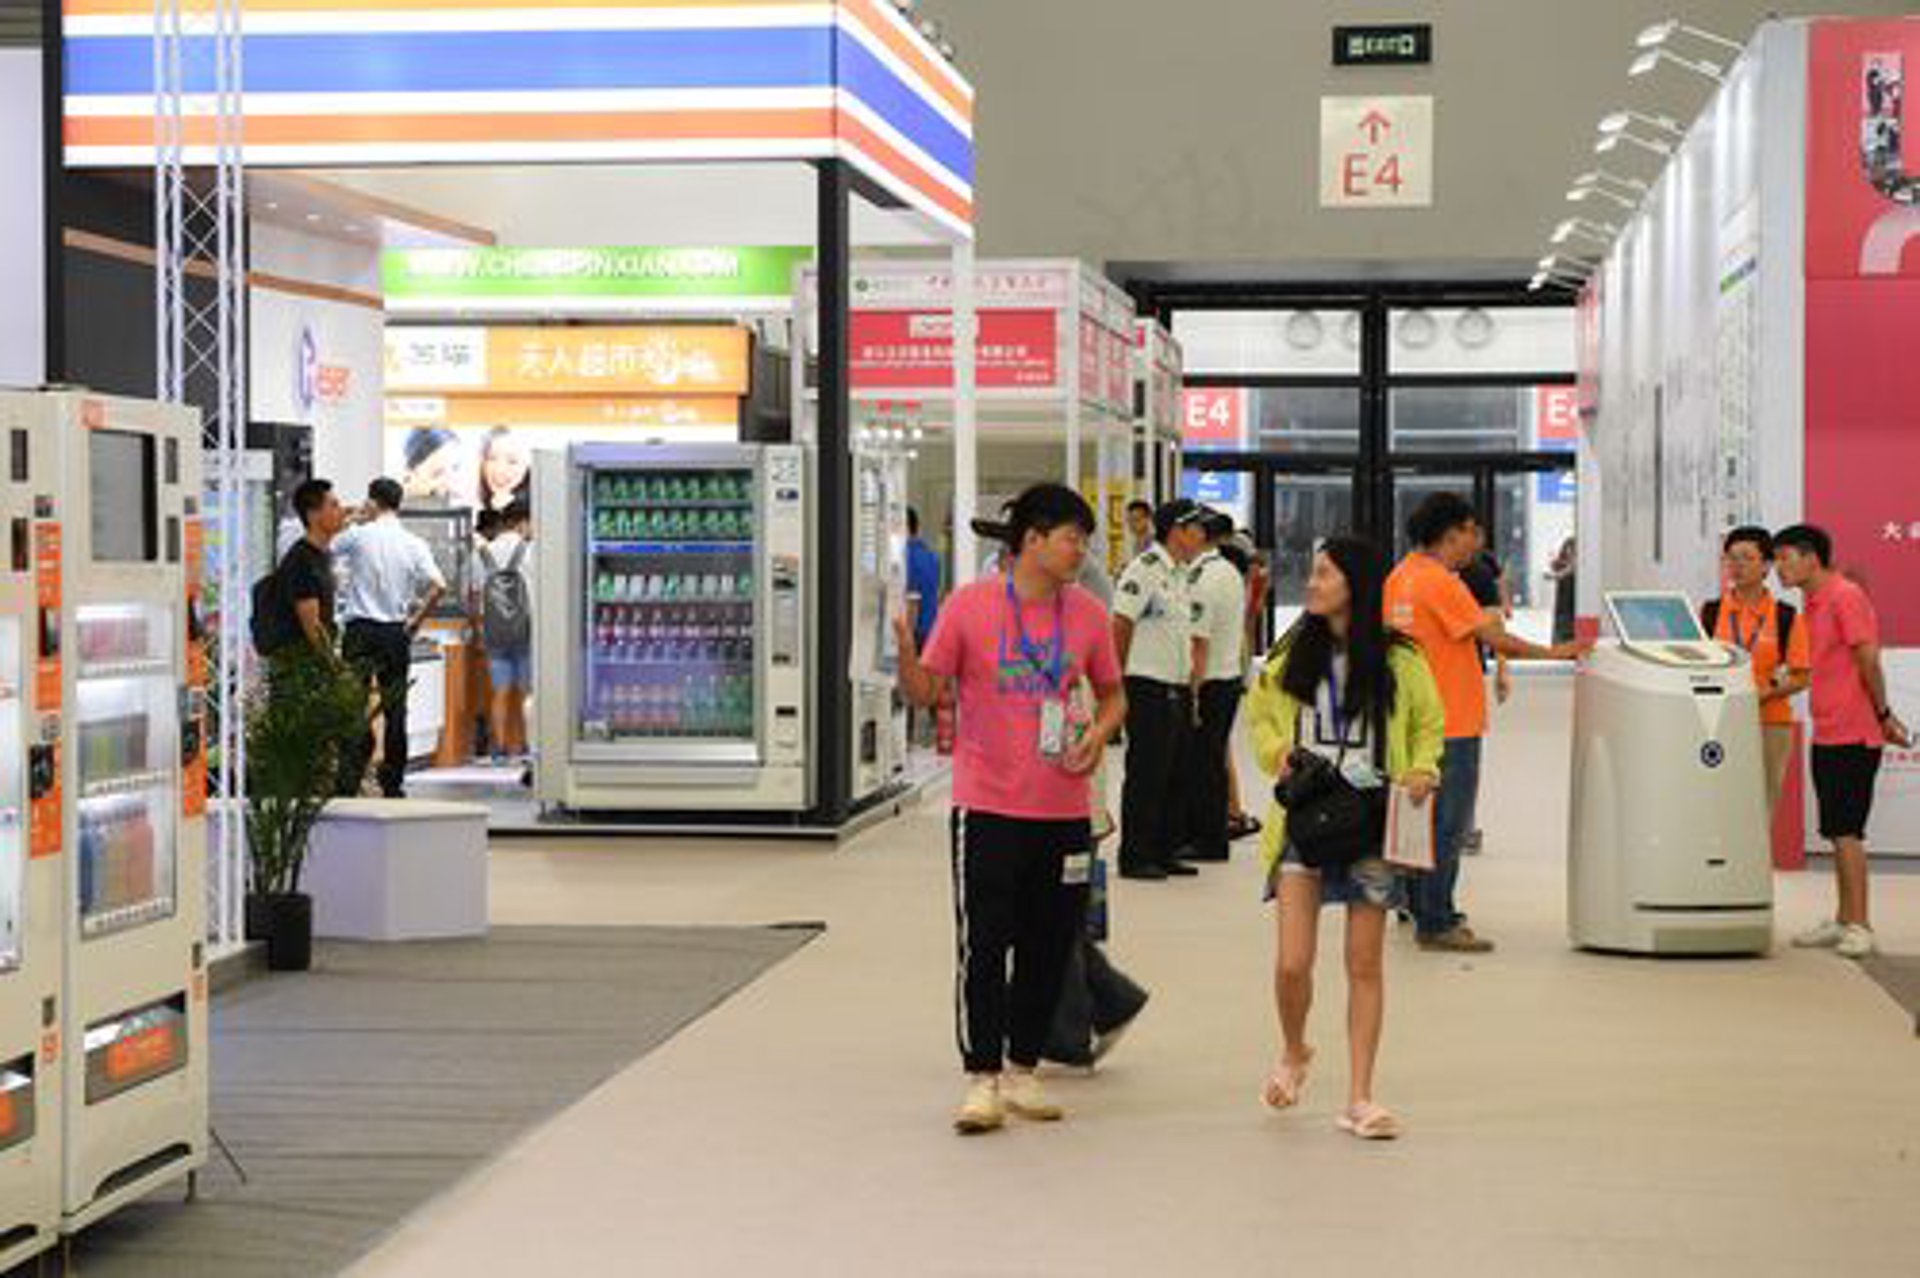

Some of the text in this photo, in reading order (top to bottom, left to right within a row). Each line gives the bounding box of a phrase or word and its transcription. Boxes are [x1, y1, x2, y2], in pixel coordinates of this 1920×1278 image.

[1342, 154, 1403, 196] E4
[1186, 395, 1230, 428] E4
[1547, 393, 1577, 426] E
